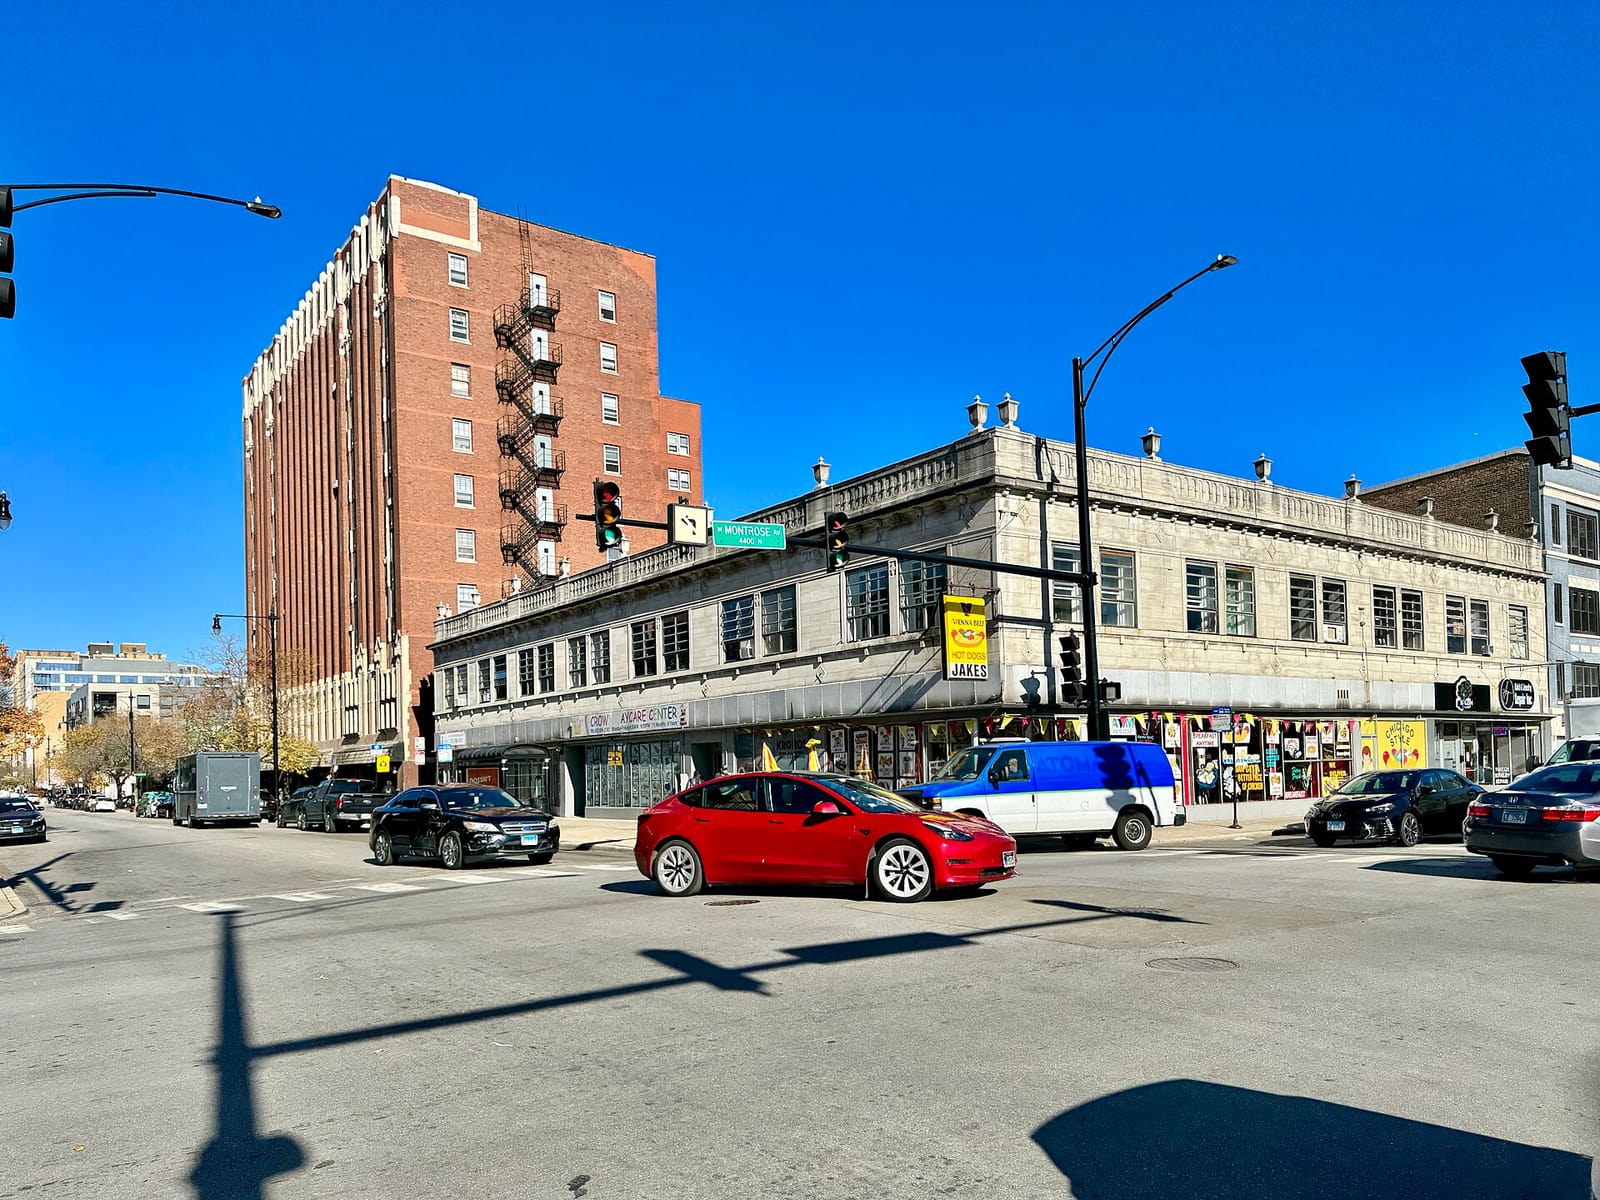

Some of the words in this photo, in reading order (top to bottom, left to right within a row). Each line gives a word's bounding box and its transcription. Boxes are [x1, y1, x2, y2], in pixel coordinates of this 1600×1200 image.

[725, 525, 771, 536] MONTROSE
[952, 618, 972, 626] VIENNA
[952, 651, 965, 660] HOT
[967, 652, 986, 661] DOGS
[952, 663, 987, 678] JAKES
[590, 713, 613, 728] CROW
[615, 709, 646, 724] AYCARE
